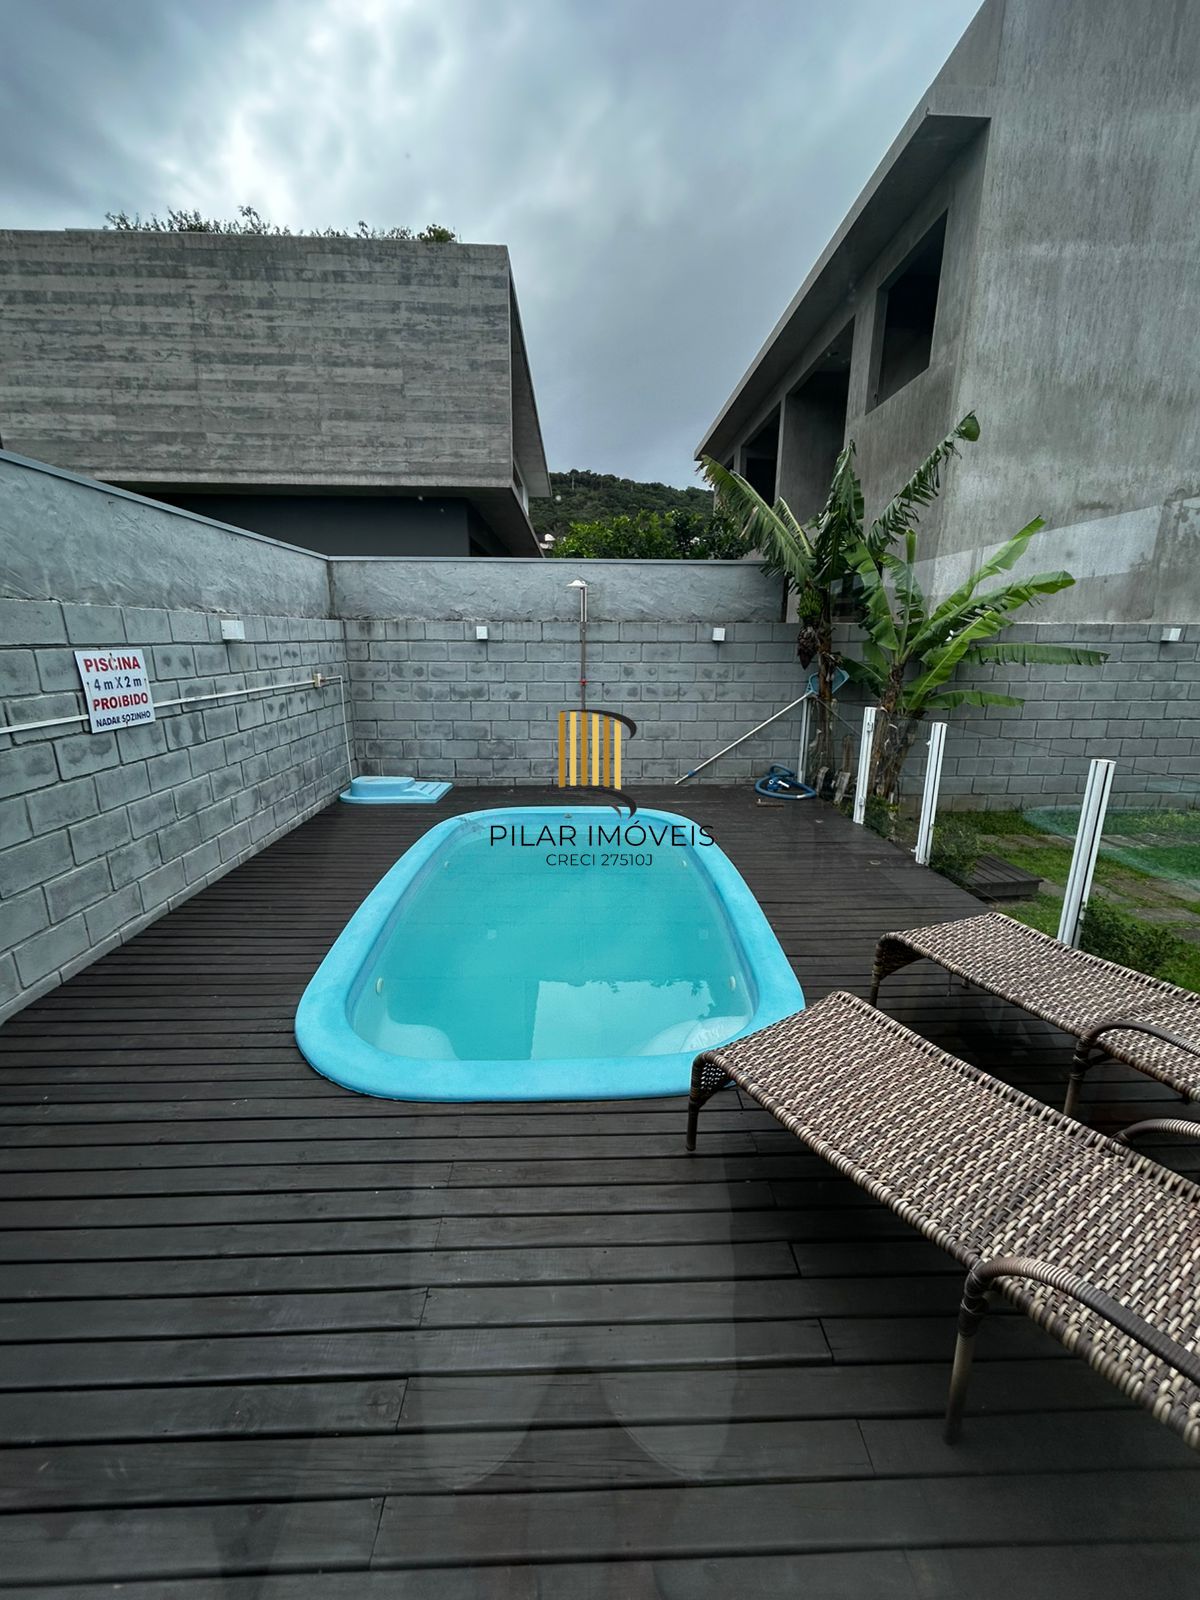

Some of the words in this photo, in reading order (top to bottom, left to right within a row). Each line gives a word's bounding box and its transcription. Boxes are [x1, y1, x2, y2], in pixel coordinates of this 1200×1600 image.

[83, 656, 141, 672] PISCINA
[94, 679, 101, 691] 4
[103, 681, 114, 690] m
[124, 676, 131, 688] 2
[133, 678, 142, 687] m
[93, 692, 148, 711] PROIBIDO
[96, 717, 120, 727] NADAR
[122, 711, 151, 723] SOZINHO
